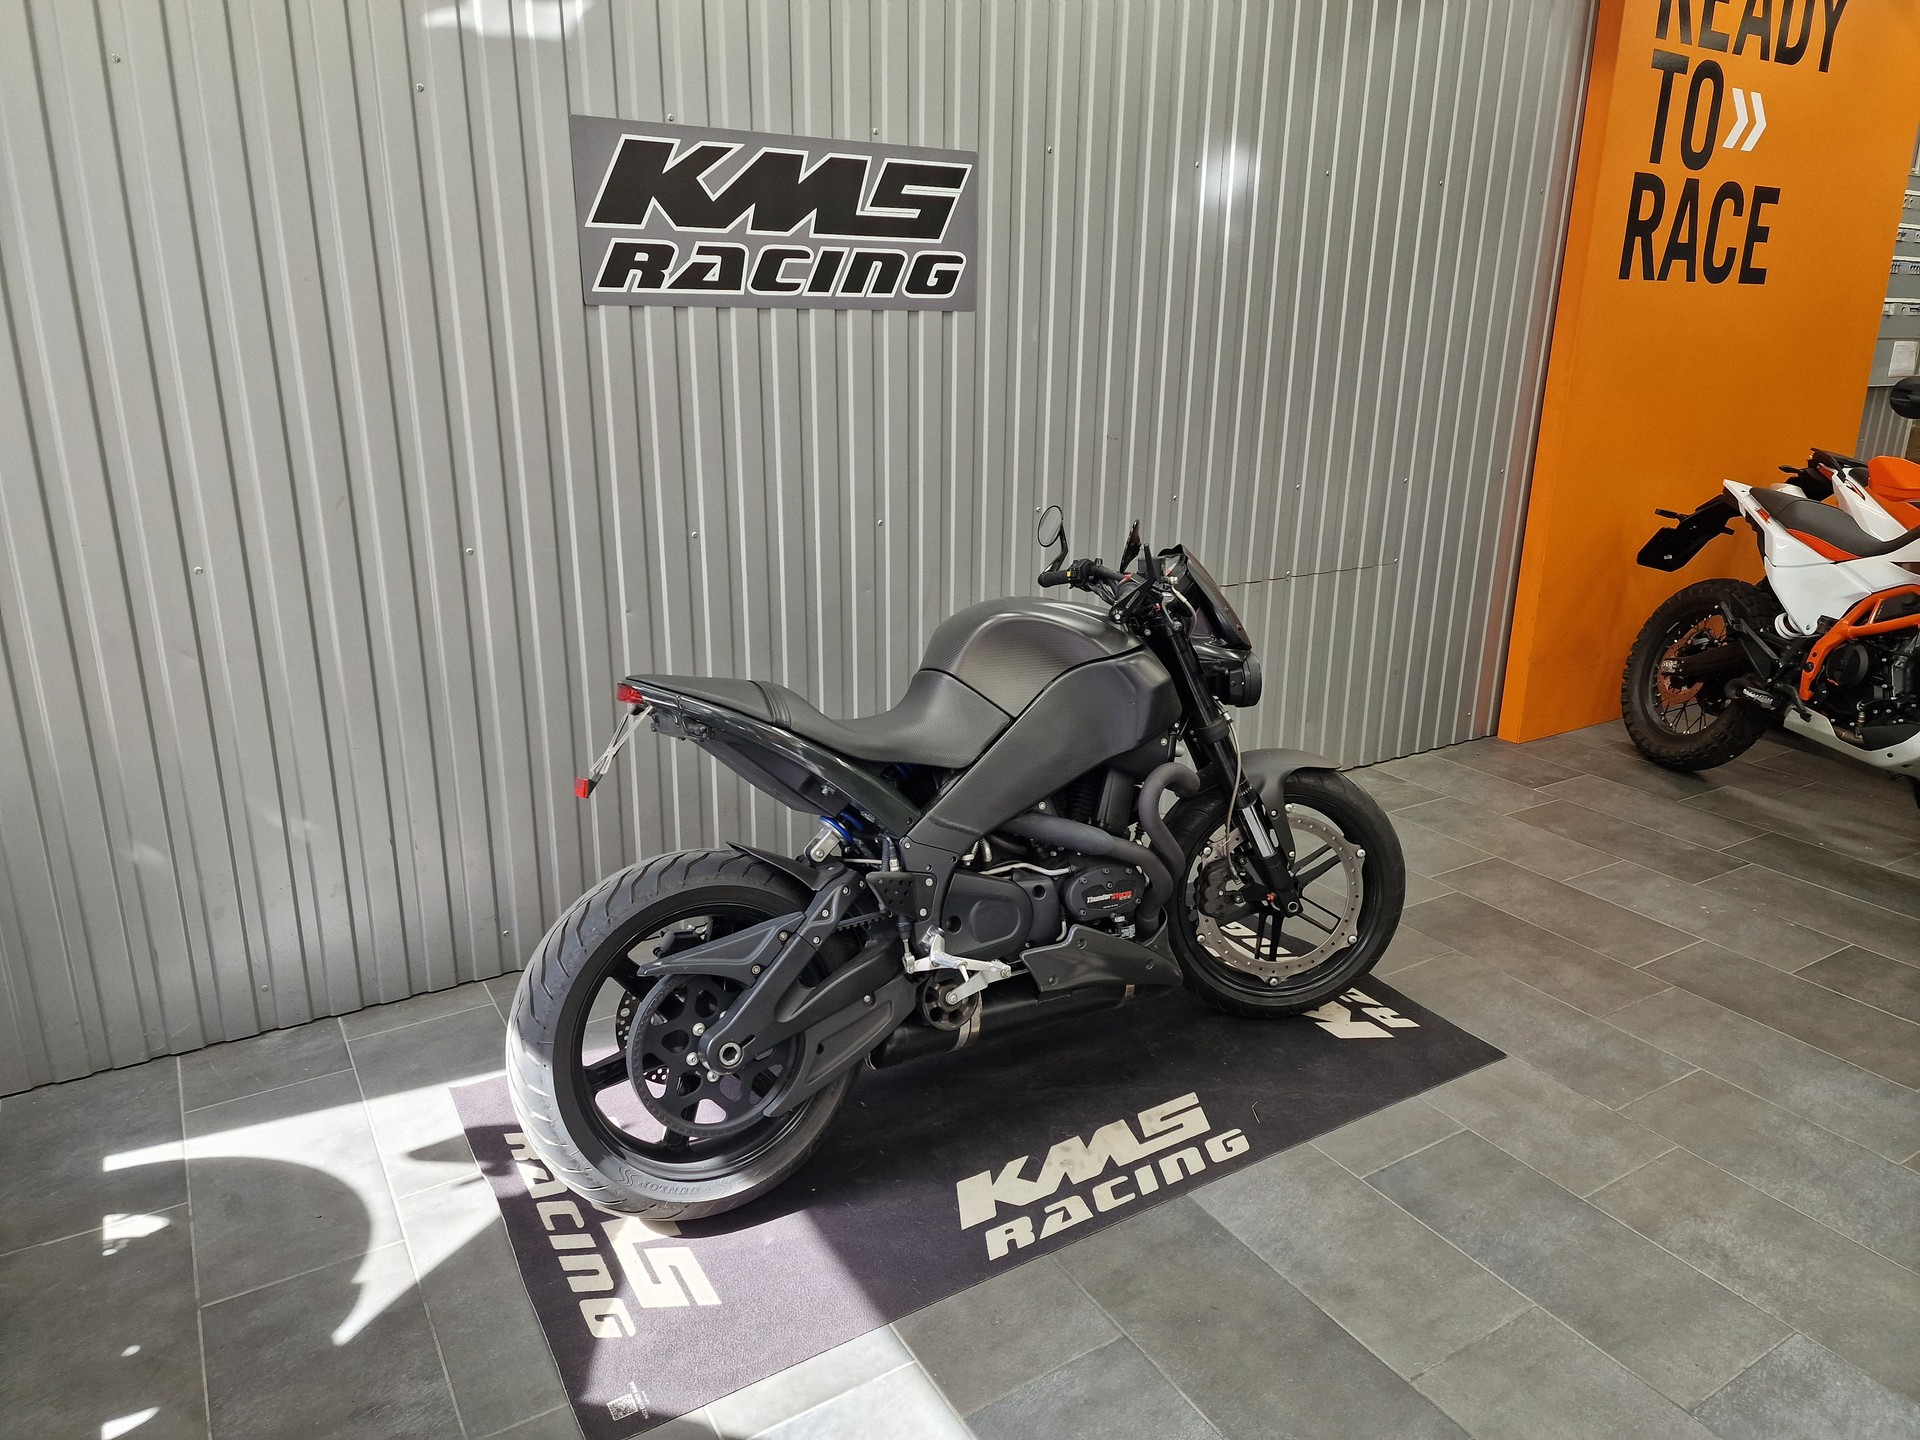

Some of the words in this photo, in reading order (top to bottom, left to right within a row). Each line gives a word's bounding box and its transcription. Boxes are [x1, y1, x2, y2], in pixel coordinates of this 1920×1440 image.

[1649, 48, 1725, 171] TO
[585, 133, 973, 244] KMS
[1618, 171, 1781, 285] RACE
[592, 237, 967, 299] RACING
[956, 1091, 1211, 1231] KMS
[985, 1128, 1250, 1261] RACING
